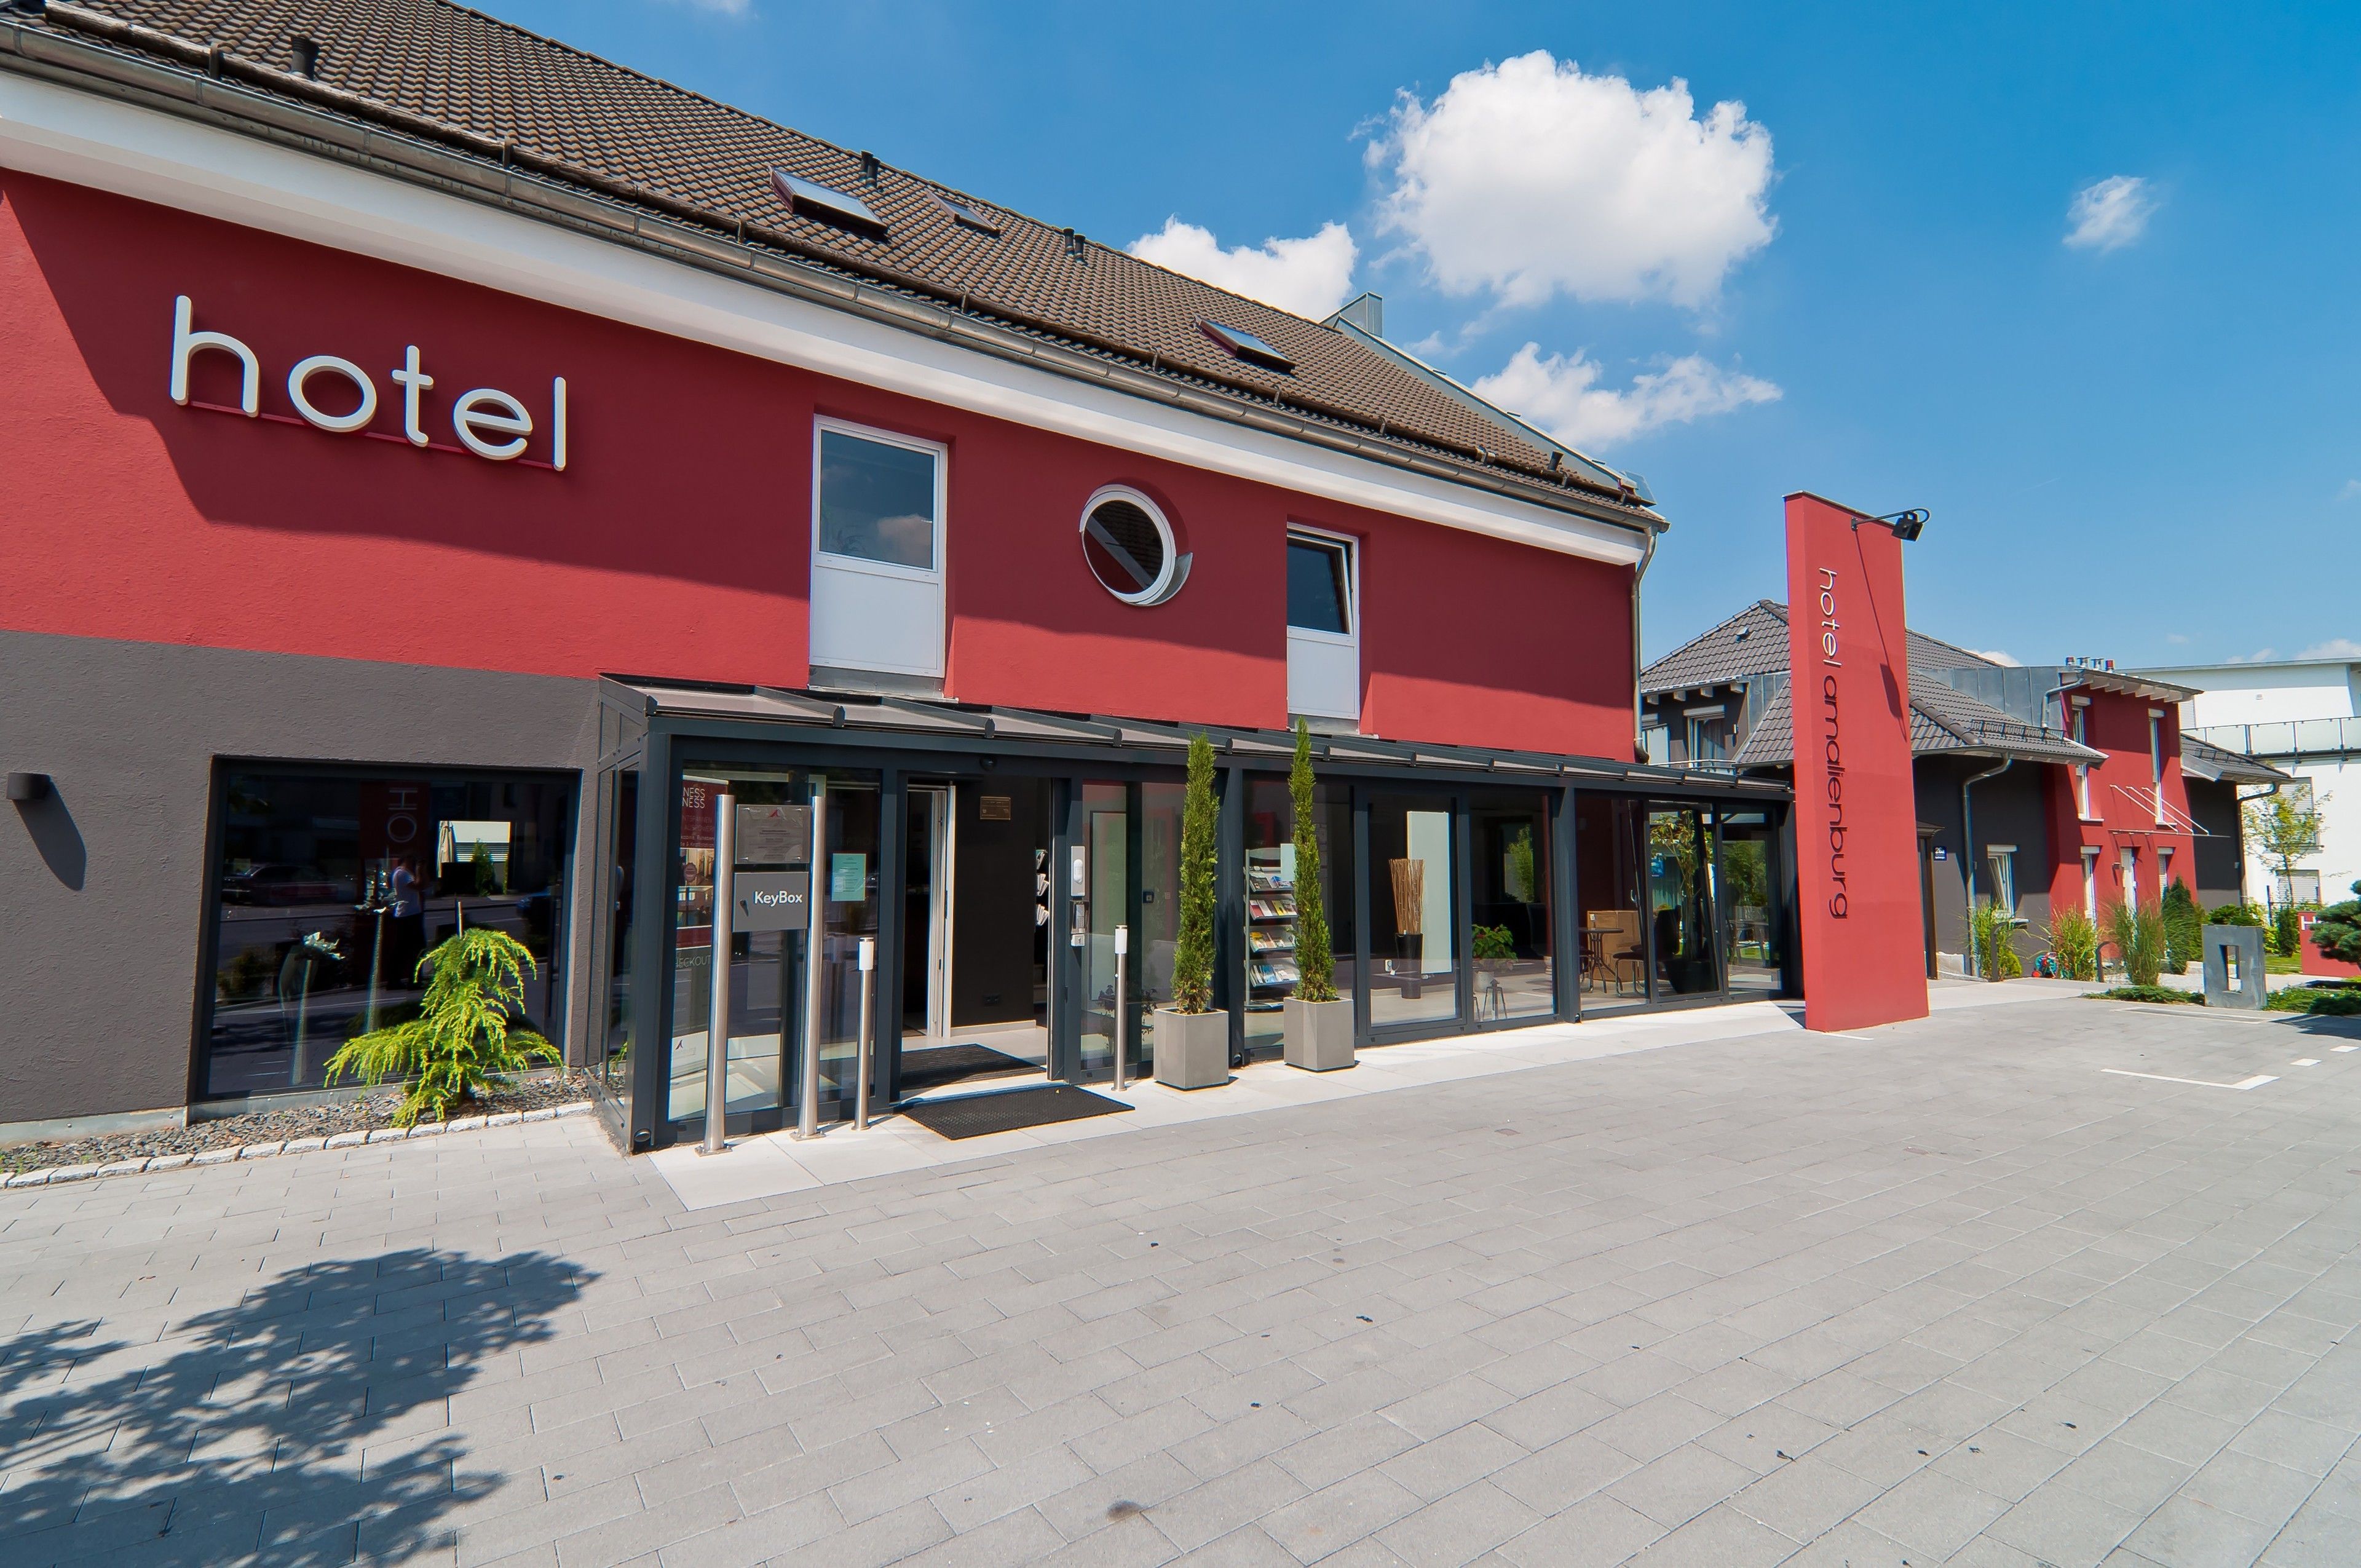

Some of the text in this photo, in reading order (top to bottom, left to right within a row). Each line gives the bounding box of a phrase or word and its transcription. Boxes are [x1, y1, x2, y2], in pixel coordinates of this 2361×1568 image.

[169, 295, 567, 472] hotel
[1818, 567, 1848, 919] hotel amalienburg
[754, 890, 803, 907] KeyBox
